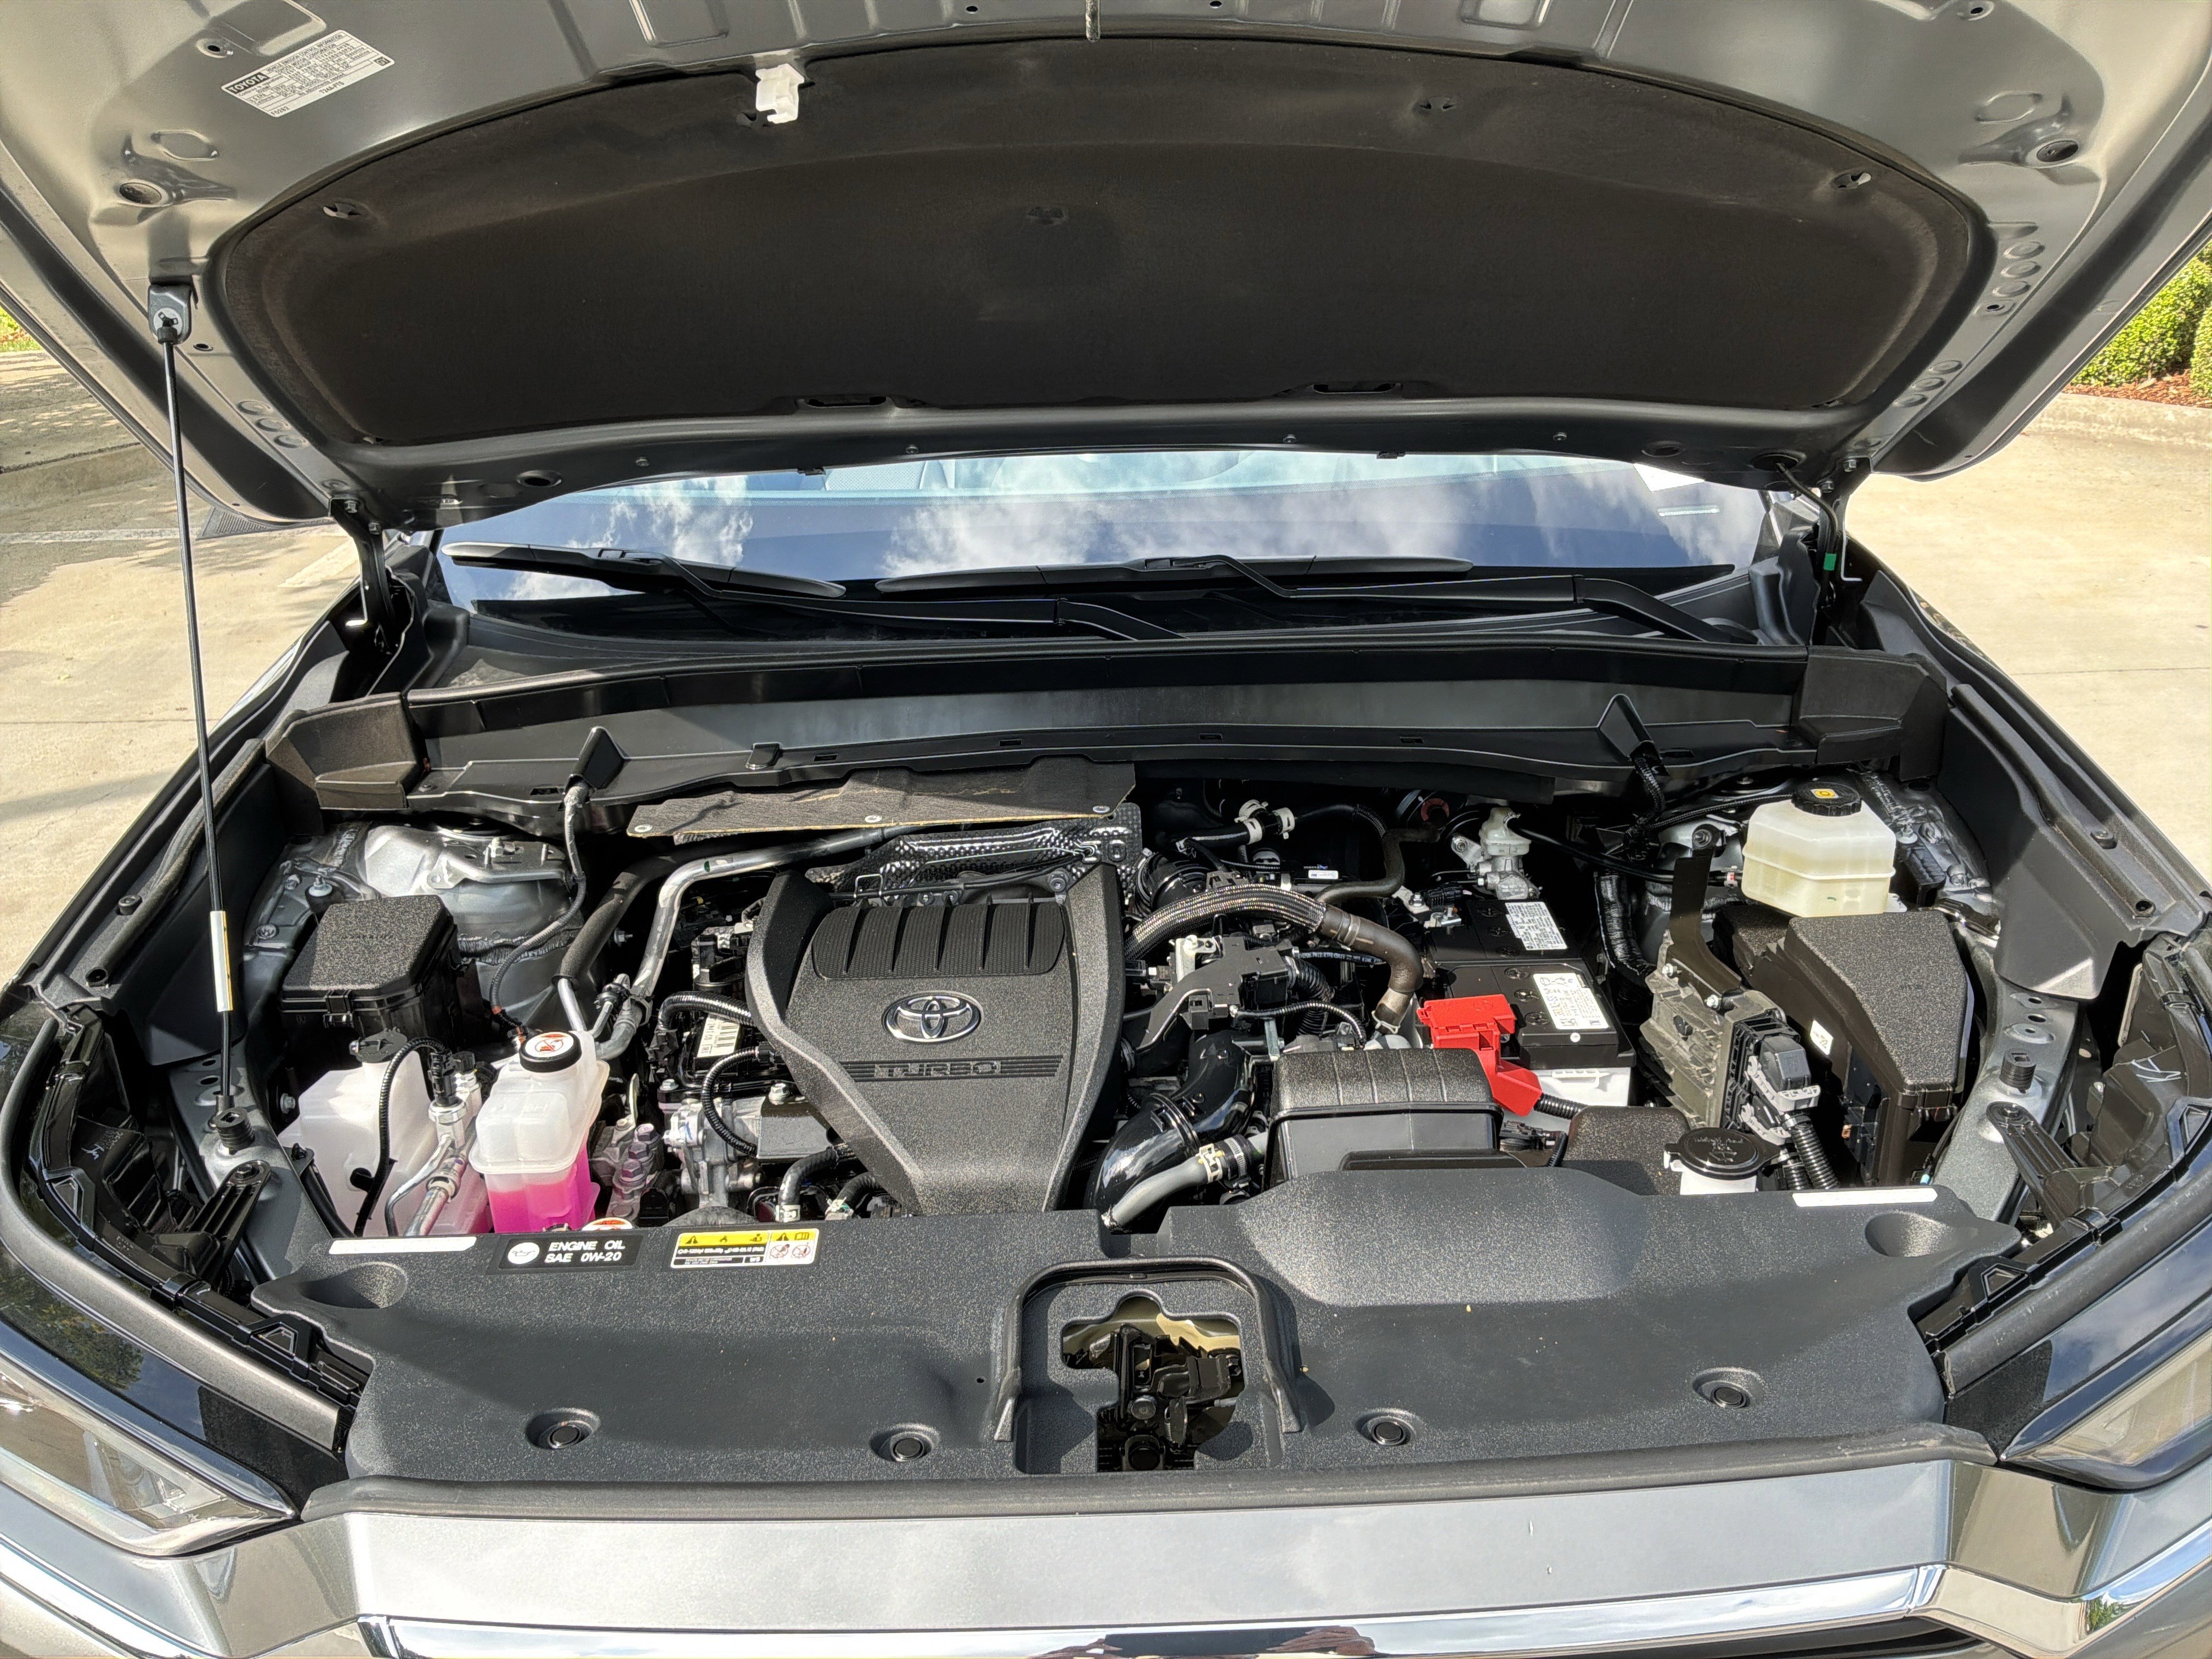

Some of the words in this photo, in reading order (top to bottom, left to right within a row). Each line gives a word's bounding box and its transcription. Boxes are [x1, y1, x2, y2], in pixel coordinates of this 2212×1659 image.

[316, 34, 343, 48] INFORMATION
[275, 64, 293, 74] TOYOTA
[291, 57, 308, 66] MOTOR
[306, 43, 337, 59] CORPORATION
[375, 57, 390, 65] GY
[228, 73, 268, 93] TOYOTA
[878, 1062, 997, 1077] TURBO
[548, 1240, 598, 1251] ENGINE
[604, 1240, 625, 1250] OIL
[544, 1253, 573, 1263] SAE
[580, 1251, 622, 1262] 0W-20
